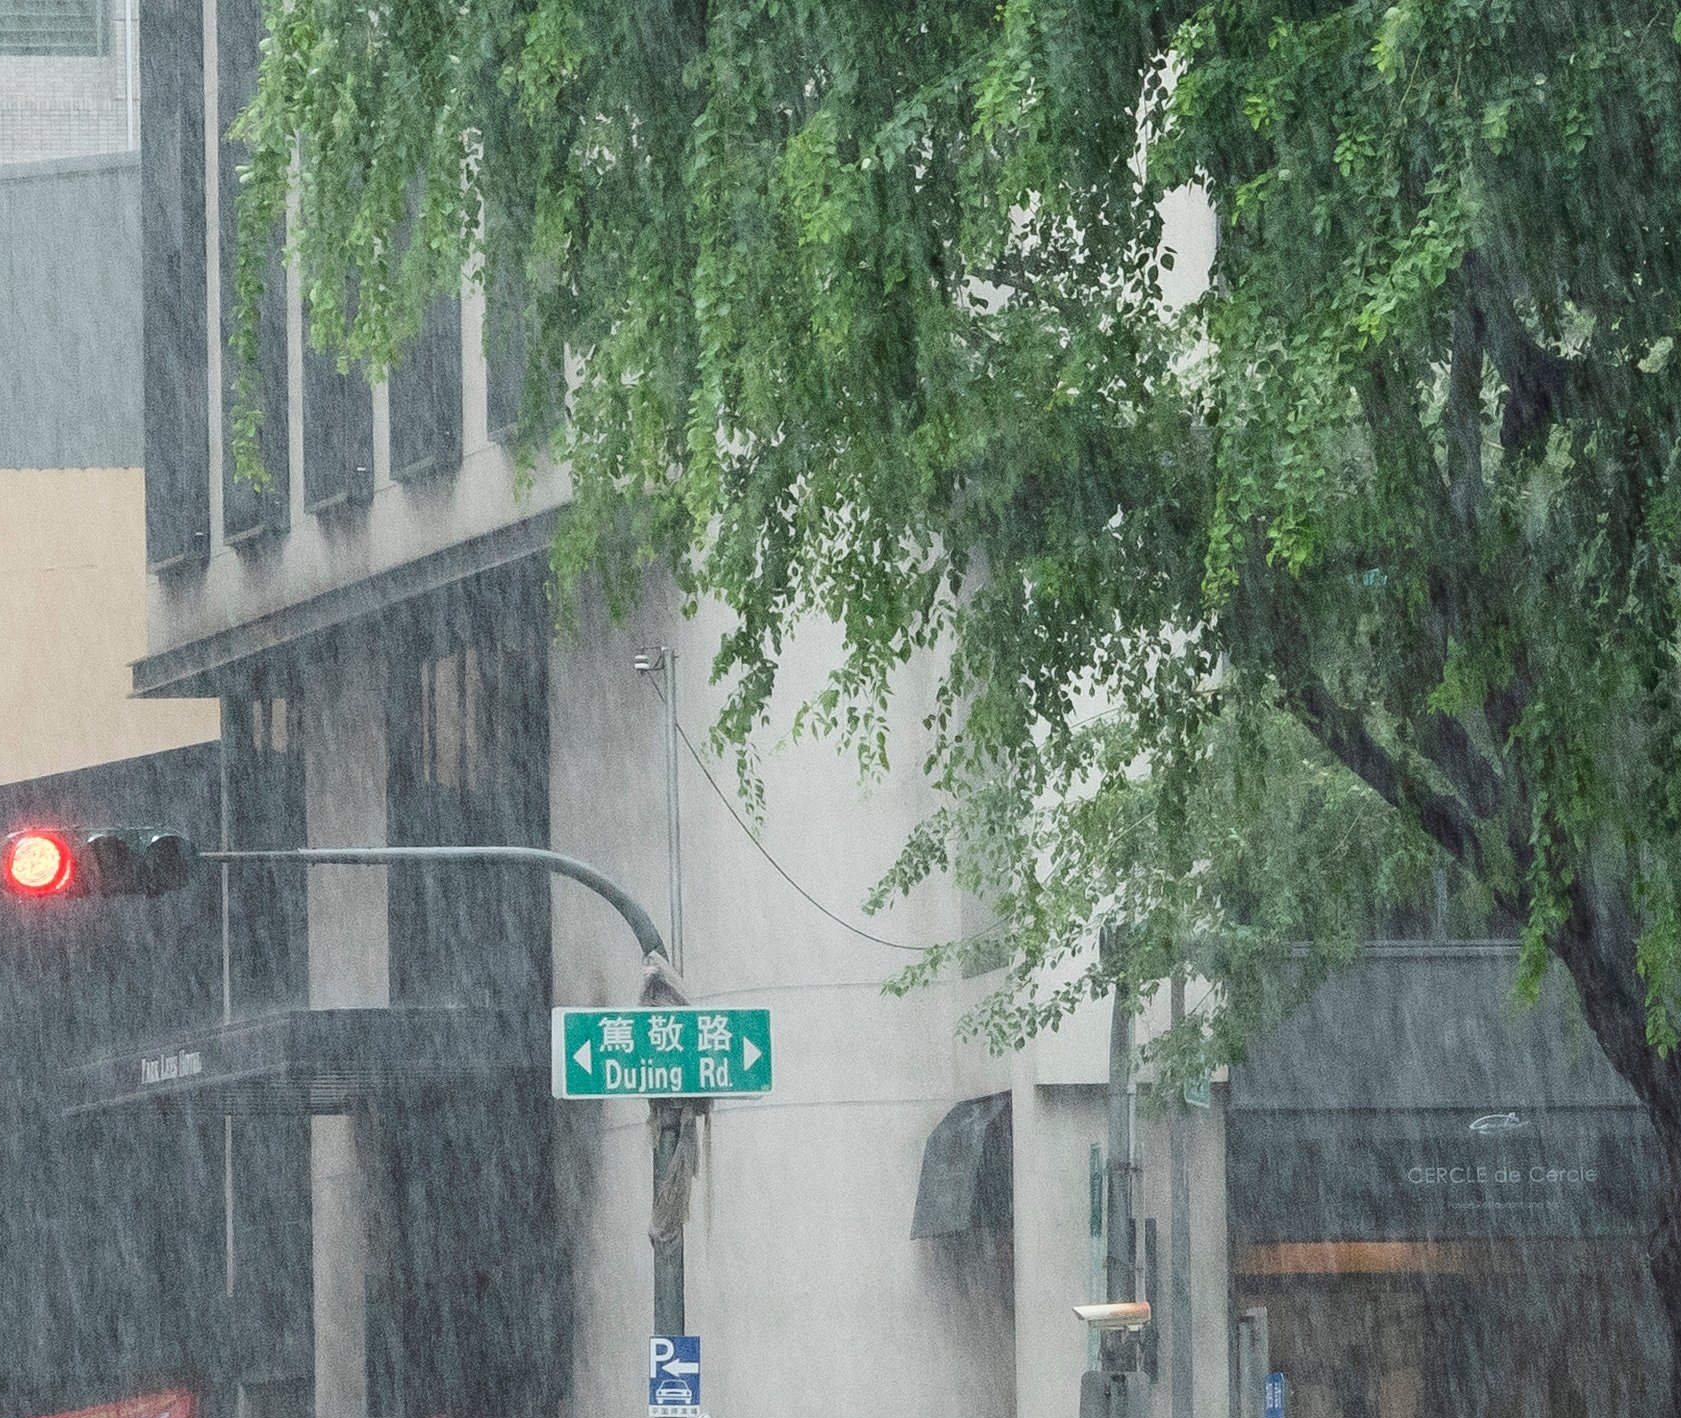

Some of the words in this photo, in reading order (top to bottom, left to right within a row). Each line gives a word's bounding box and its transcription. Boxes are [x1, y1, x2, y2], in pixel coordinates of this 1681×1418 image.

[598, 1014, 734, 1053] 篤敬路
[605, 1057, 683, 1092] Dujing
[699, 1057, 734, 1089] Rd.
[1407, 1166, 1489, 1184] CERCLE
[1494, 1166, 1520, 1183] de
[1529, 1166, 1599, 1183] Cercle
[650, 1337, 675, 1379] P
